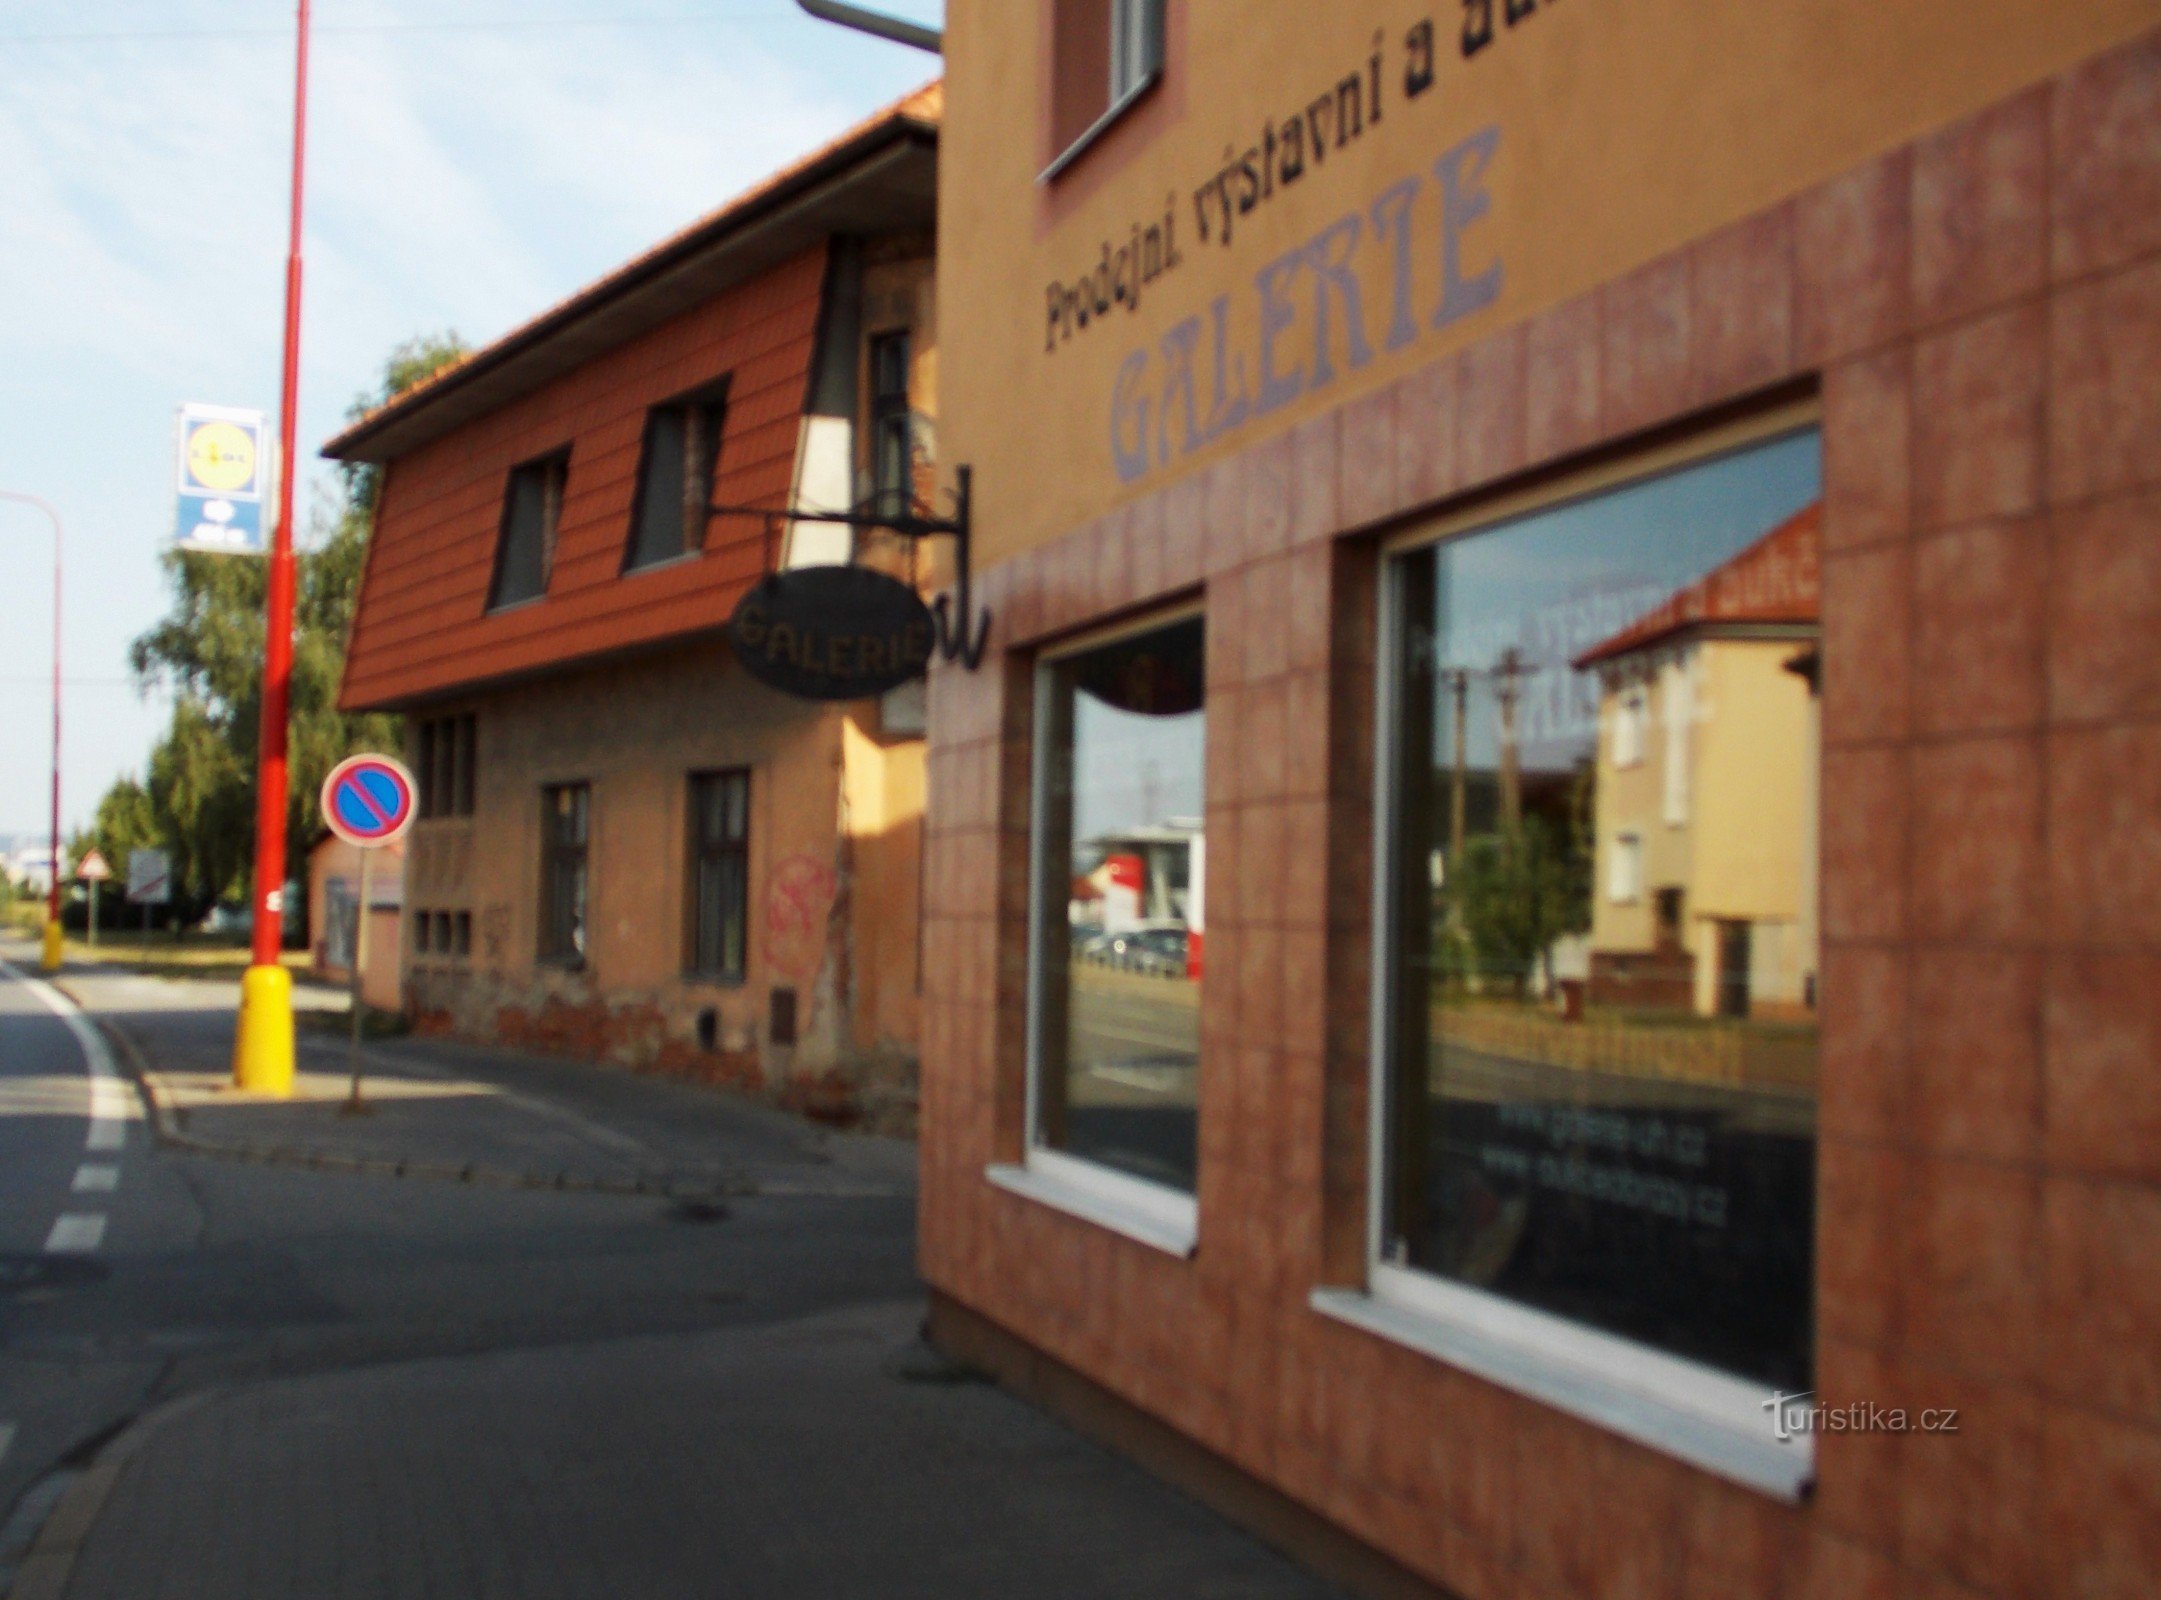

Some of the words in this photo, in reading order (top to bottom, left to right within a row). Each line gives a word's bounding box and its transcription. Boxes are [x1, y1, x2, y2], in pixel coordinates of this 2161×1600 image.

[1404, 17, 1435, 98] a
[1109, 123, 1506, 485] GALERIE
[735, 603, 930, 677] GALERIE
